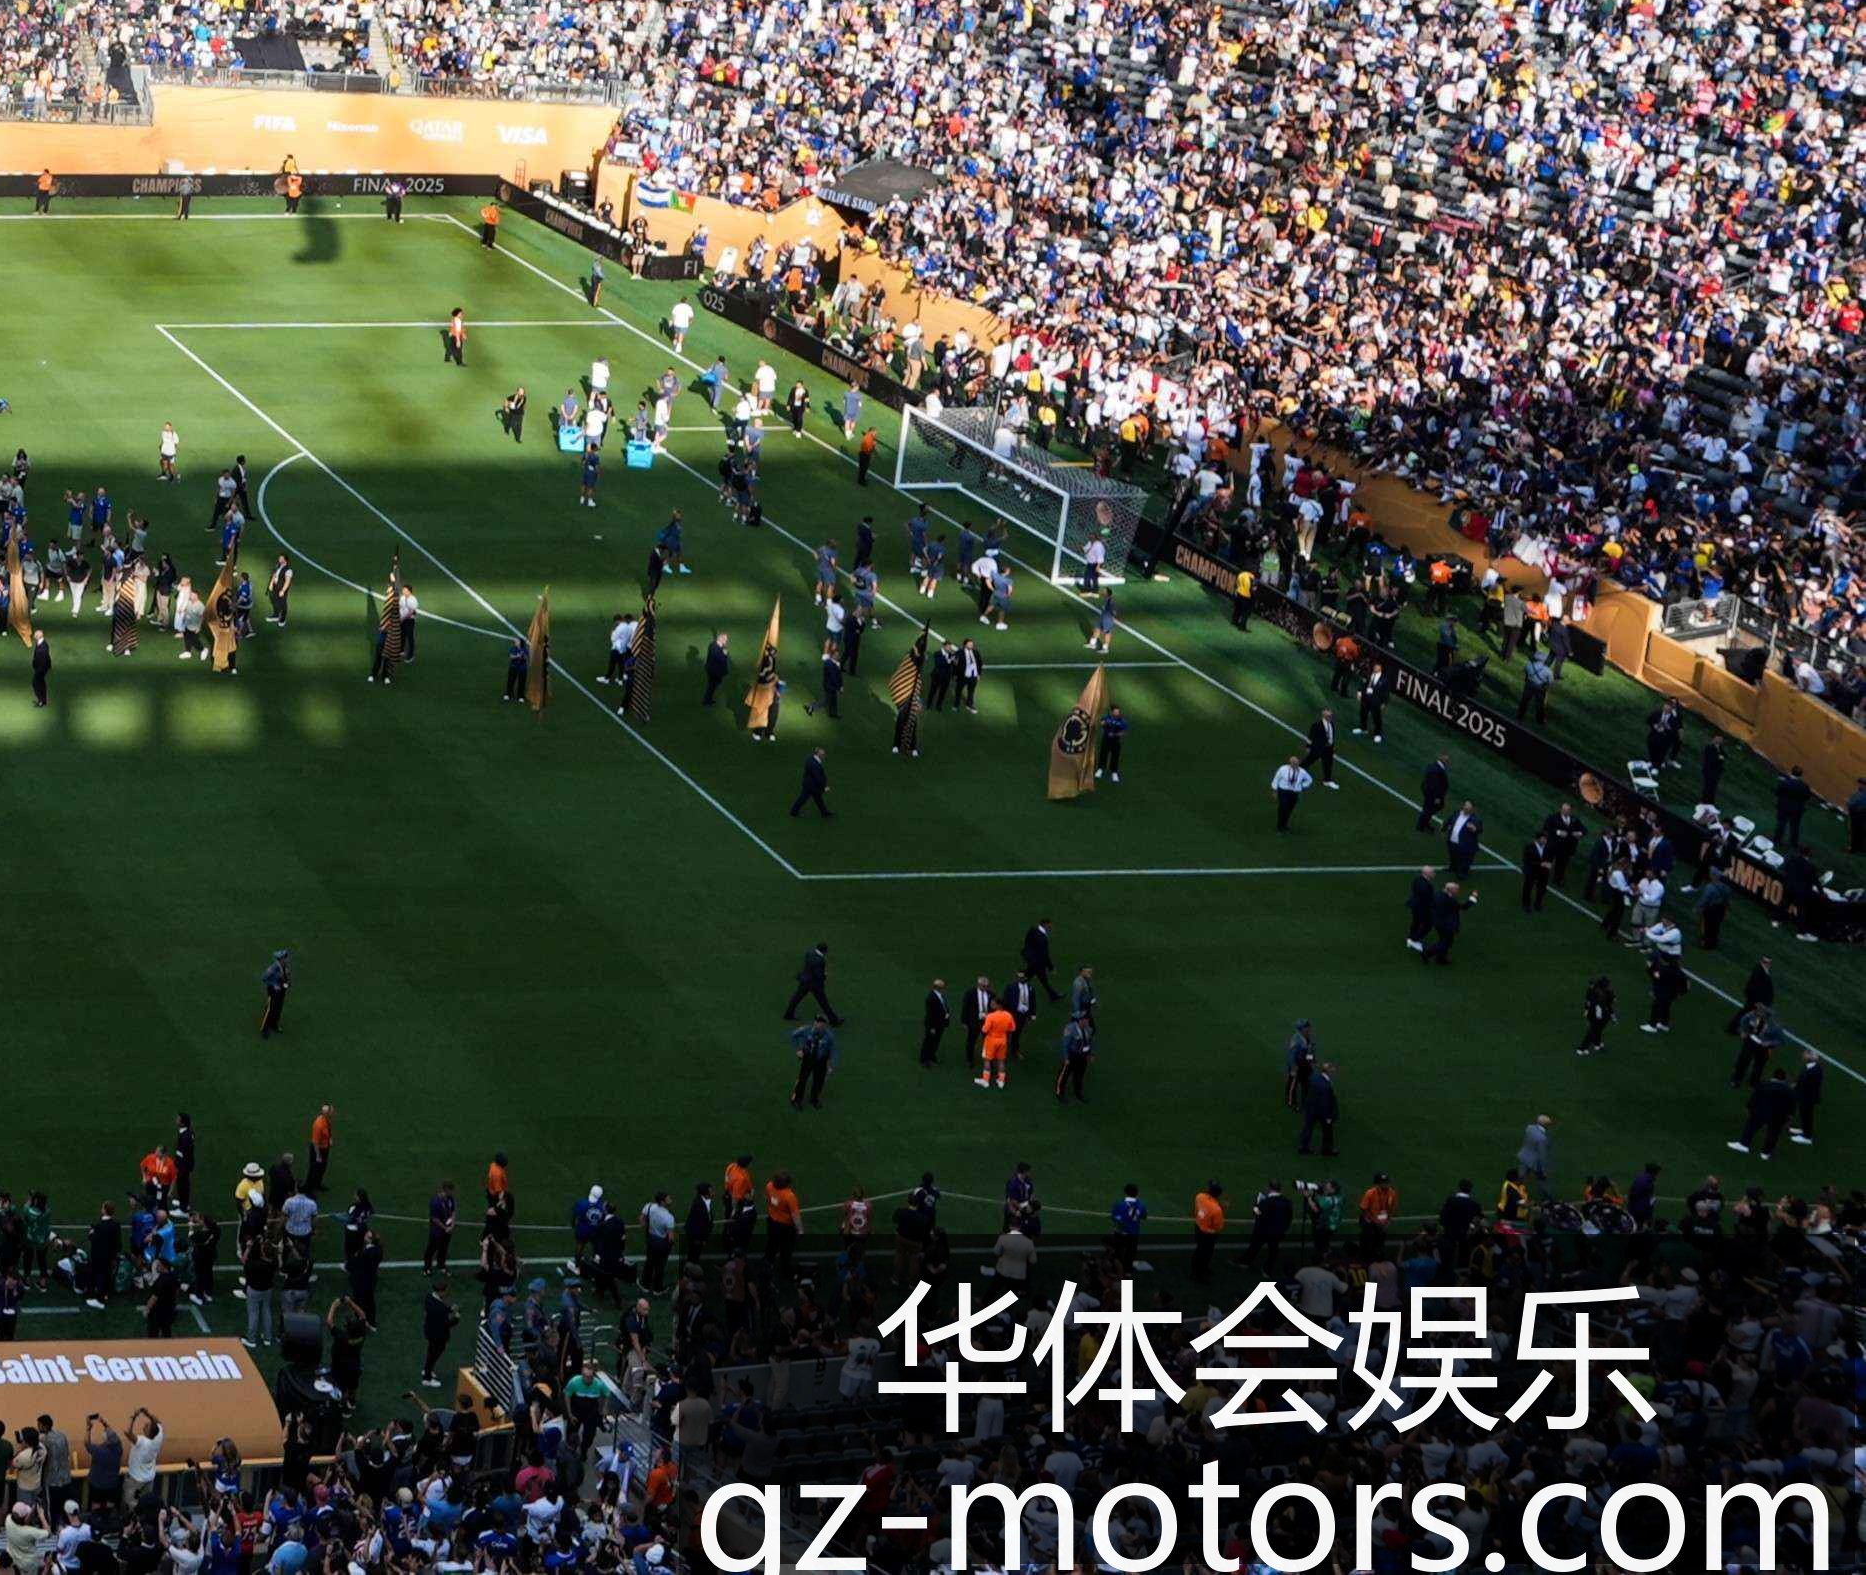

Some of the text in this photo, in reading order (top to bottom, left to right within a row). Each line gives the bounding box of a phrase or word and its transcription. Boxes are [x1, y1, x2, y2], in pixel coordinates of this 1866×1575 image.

[497, 124, 549, 146] VISA
[408, 179, 445, 193] 2025
[703, 290, 726, 313] 025
[1175, 543, 1237, 593] CHAMPION
[1395, 669, 1507, 749] FINAL 2025
